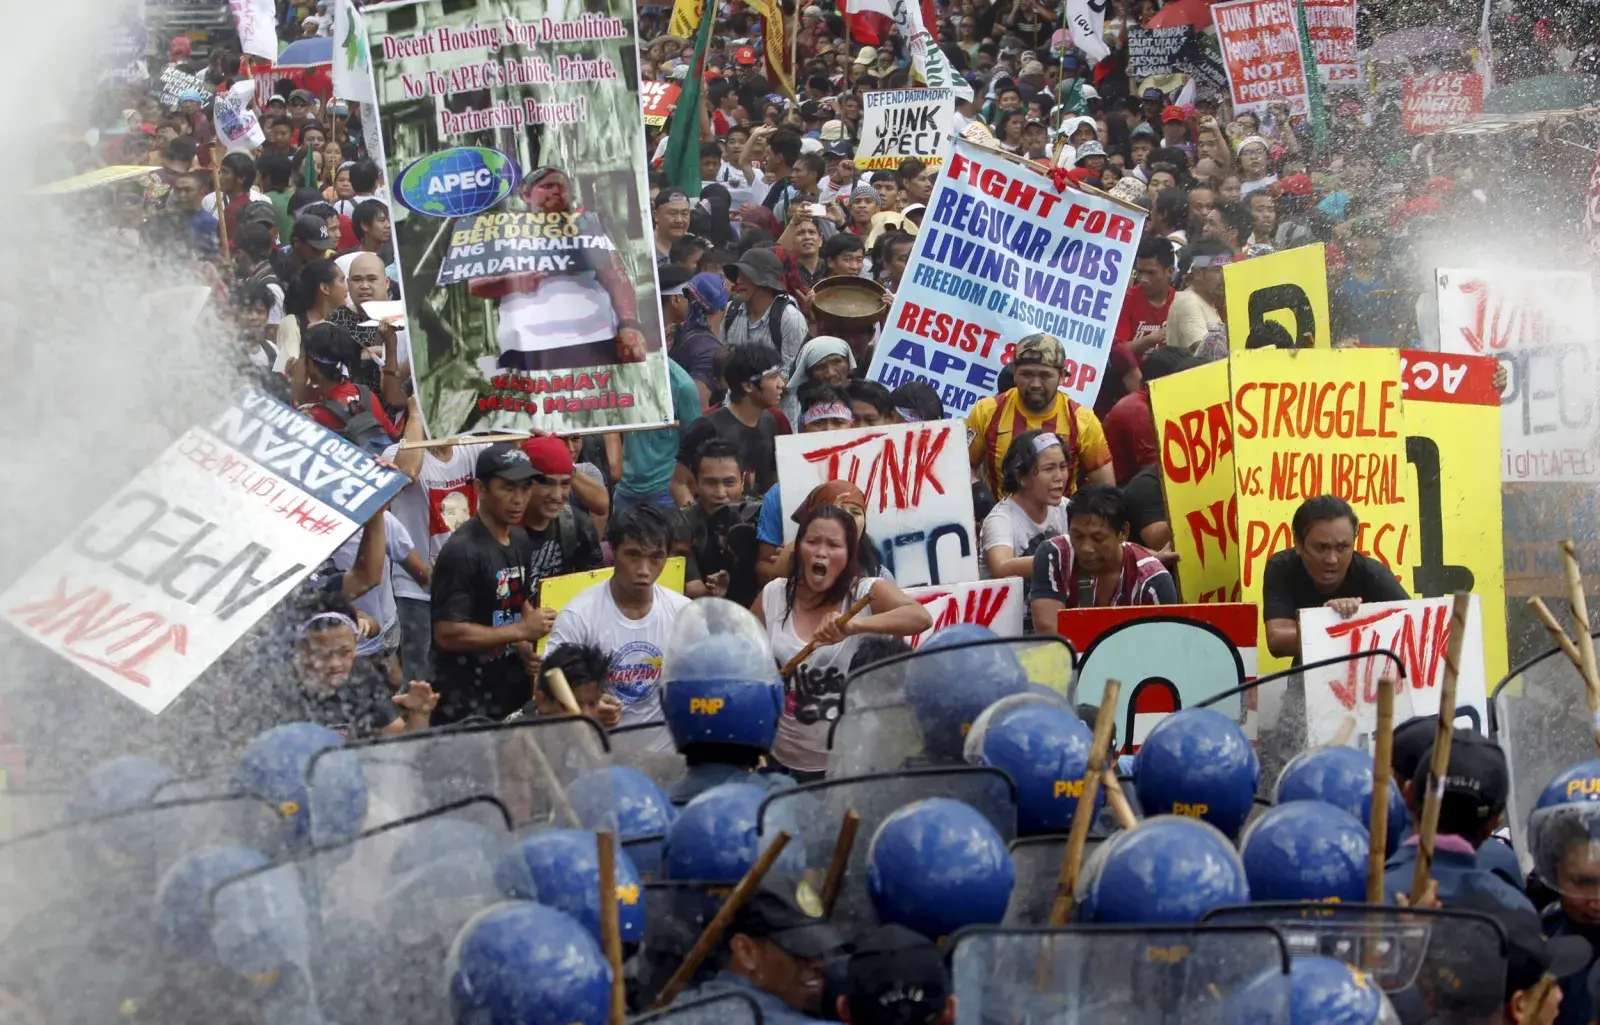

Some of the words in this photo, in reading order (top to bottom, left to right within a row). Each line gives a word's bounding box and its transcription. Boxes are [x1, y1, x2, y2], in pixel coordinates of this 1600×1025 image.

[384, 34, 434, 60] Decent
[504, 18, 536, 49] Stop
[541, 13, 627, 40] Demolition.
[1221, 6, 1253, 32] JUNK
[1255, 1, 1290, 26] APEC!
[1262, 27, 1298, 55] Health
[402, 74, 423, 99] No
[426, 70, 446, 95] To
[449, 63, 504, 92] APEC's
[640, 81, 670, 95] NK
[1240, 77, 1298, 101] PROFIT!
[1242, 61, 1284, 80] NOT
[440, 99, 523, 135] Partnership
[525, 94, 577, 129] Project
[867, 92, 904, 108] DEFEND
[876, 106, 941, 138] JUNK
[872, 132, 940, 157] APEC!
[427, 167, 492, 195] APEC
[946, 153, 1062, 219] FIGHT
[1063, 203, 1135, 244] FOR
[475, 211, 582, 229] NOYNOY
[932, 187, 1052, 264] REGULAR
[1048, 236, 1122, 287] JOBS
[450, 243, 485, 260] NG
[921, 228, 1021, 291] LIVING
[1024, 267, 1112, 322] WAGE
[912, 263, 988, 307] FREEDOM
[988, 289, 1010, 314] OF
[1007, 300, 1106, 349] ASSOCIATION
[897, 301, 1002, 359] RESIST
[492, 371, 612, 394] KADAMAY
[887, 338, 998, 391] APE
[543, 392, 635, 415] Manila
[943, 379, 987, 413] EXP
[1236, 380, 1398, 440] STRUGGLE
[1499, 344, 1592, 436] PEC
[241, 387, 323, 450] MANILA
[211, 405, 377, 513] BAYAN
[319, 436, 399, 489] METRO
[1163, 401, 1234, 486] OBA
[802, 426, 950, 513] JUNK
[1269, 452, 1405, 506] NEOLIBERAL
[72, 489, 306, 622] APEC
[10, 577, 188, 688] JUNK
[1325, 606, 1452, 711] JUNK
[689, 697, 727, 715] PNP
